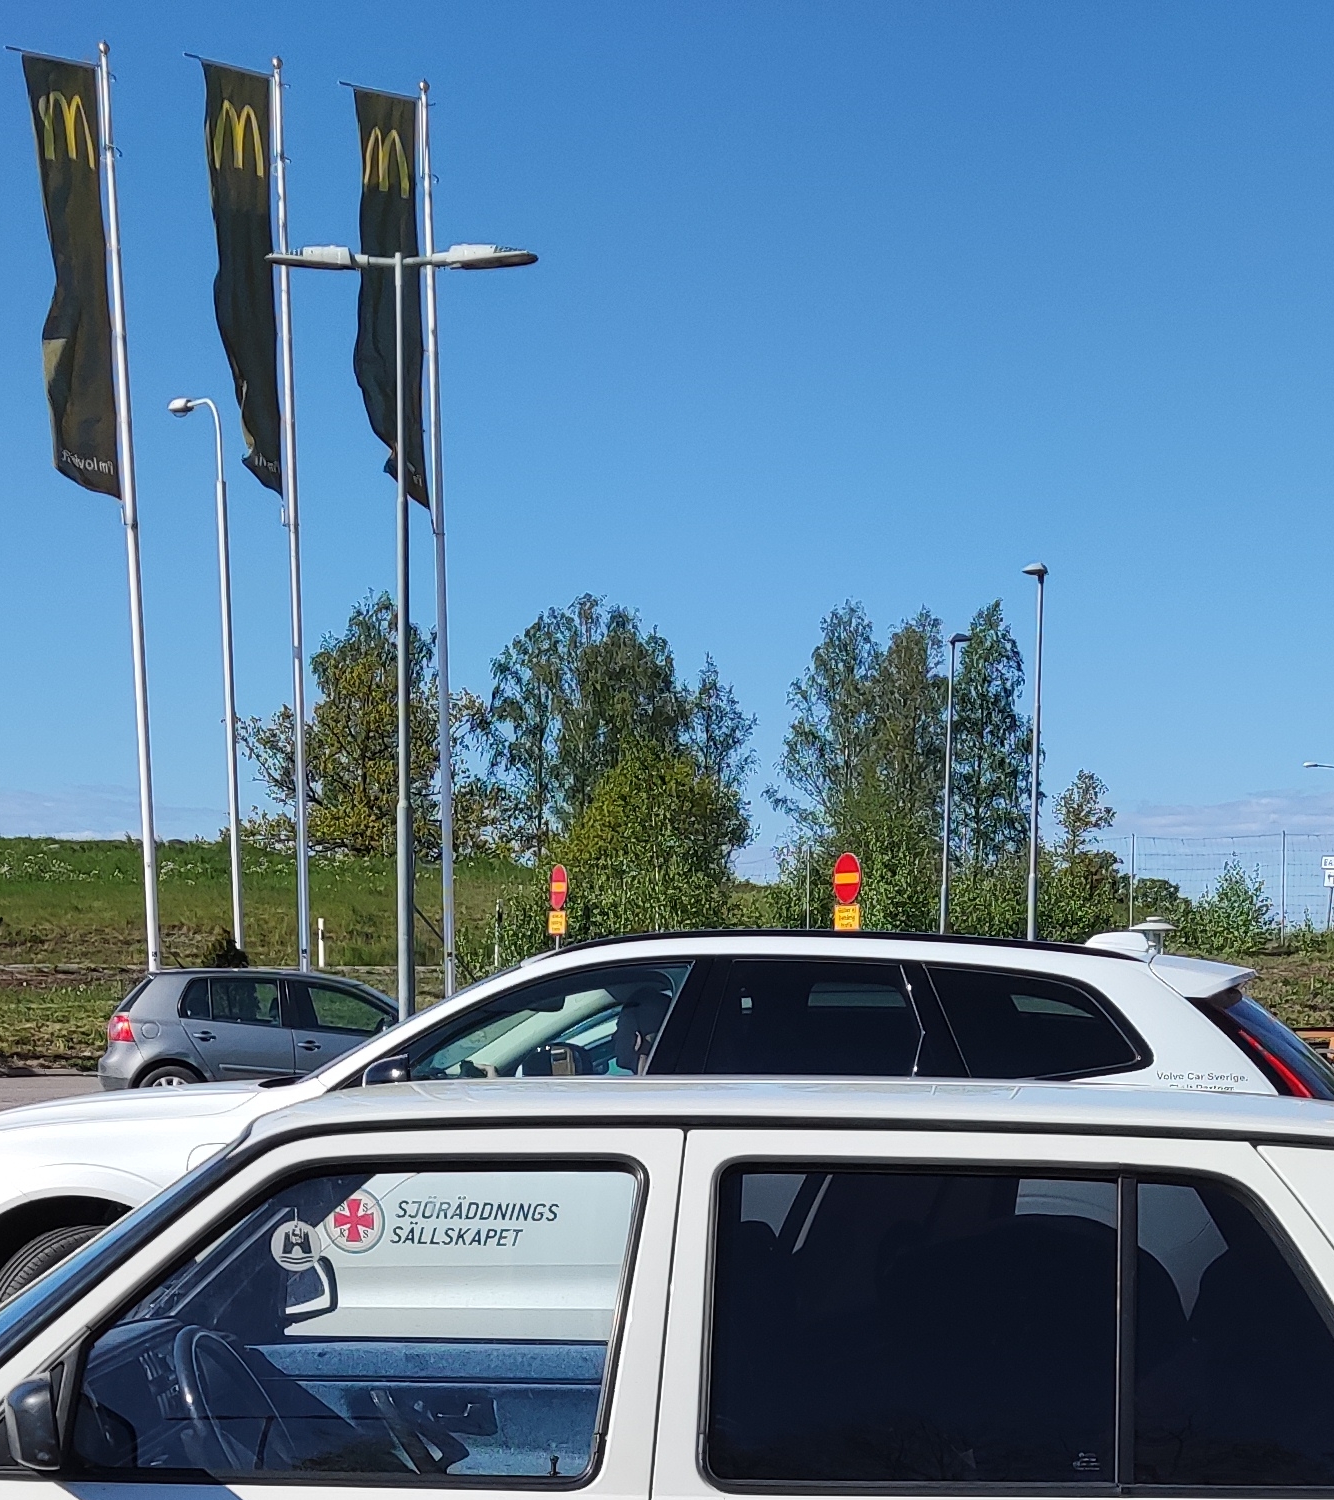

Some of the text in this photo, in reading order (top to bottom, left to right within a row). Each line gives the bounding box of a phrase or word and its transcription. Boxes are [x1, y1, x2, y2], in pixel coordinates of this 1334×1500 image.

[1187, 1072, 1205, 1081] Car
[395, 1195, 560, 1222] SJÖRÄDDNINGS
[389, 1221, 524, 1247] SÄLLSKAPET
